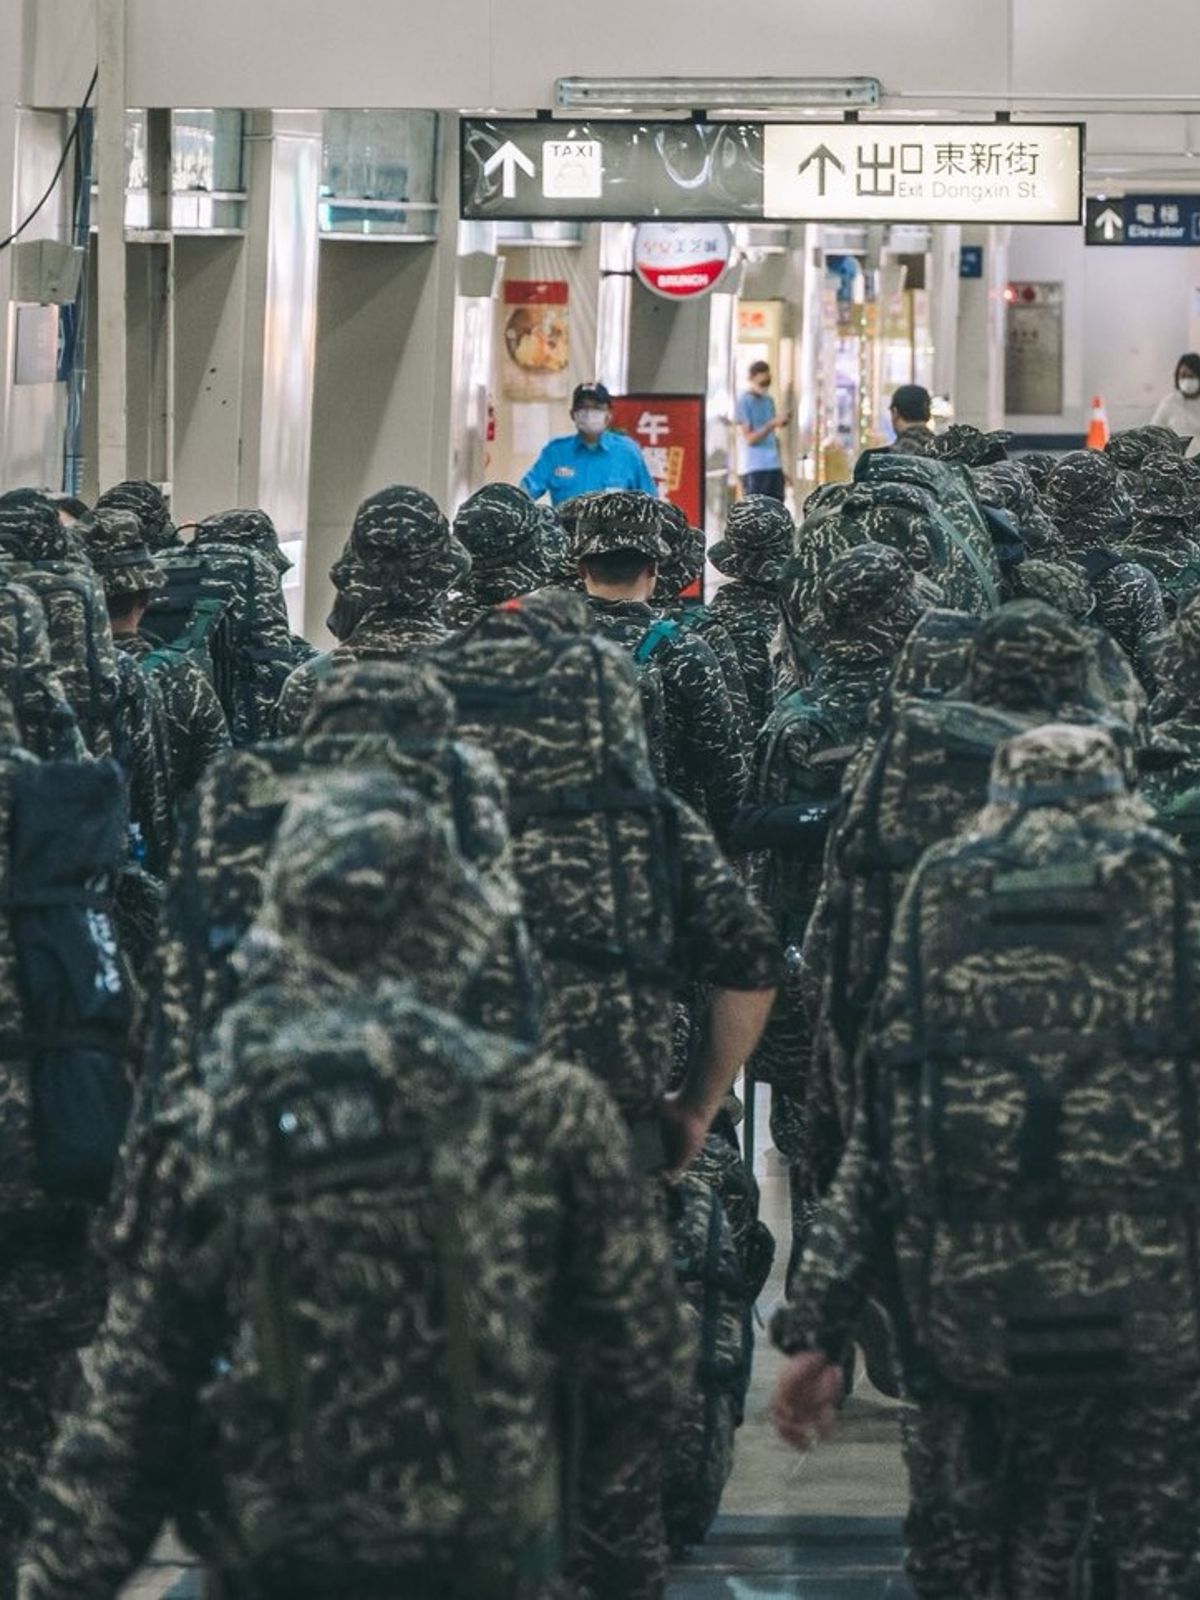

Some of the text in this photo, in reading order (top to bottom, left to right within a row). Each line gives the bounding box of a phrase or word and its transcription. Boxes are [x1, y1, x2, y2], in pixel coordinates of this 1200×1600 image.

[551, 145, 594, 157] TAXI
[934, 142, 1040, 175] 東新街
[932, 182, 1010, 203] Dongxin
[1128, 224, 1185, 238] Elevator
